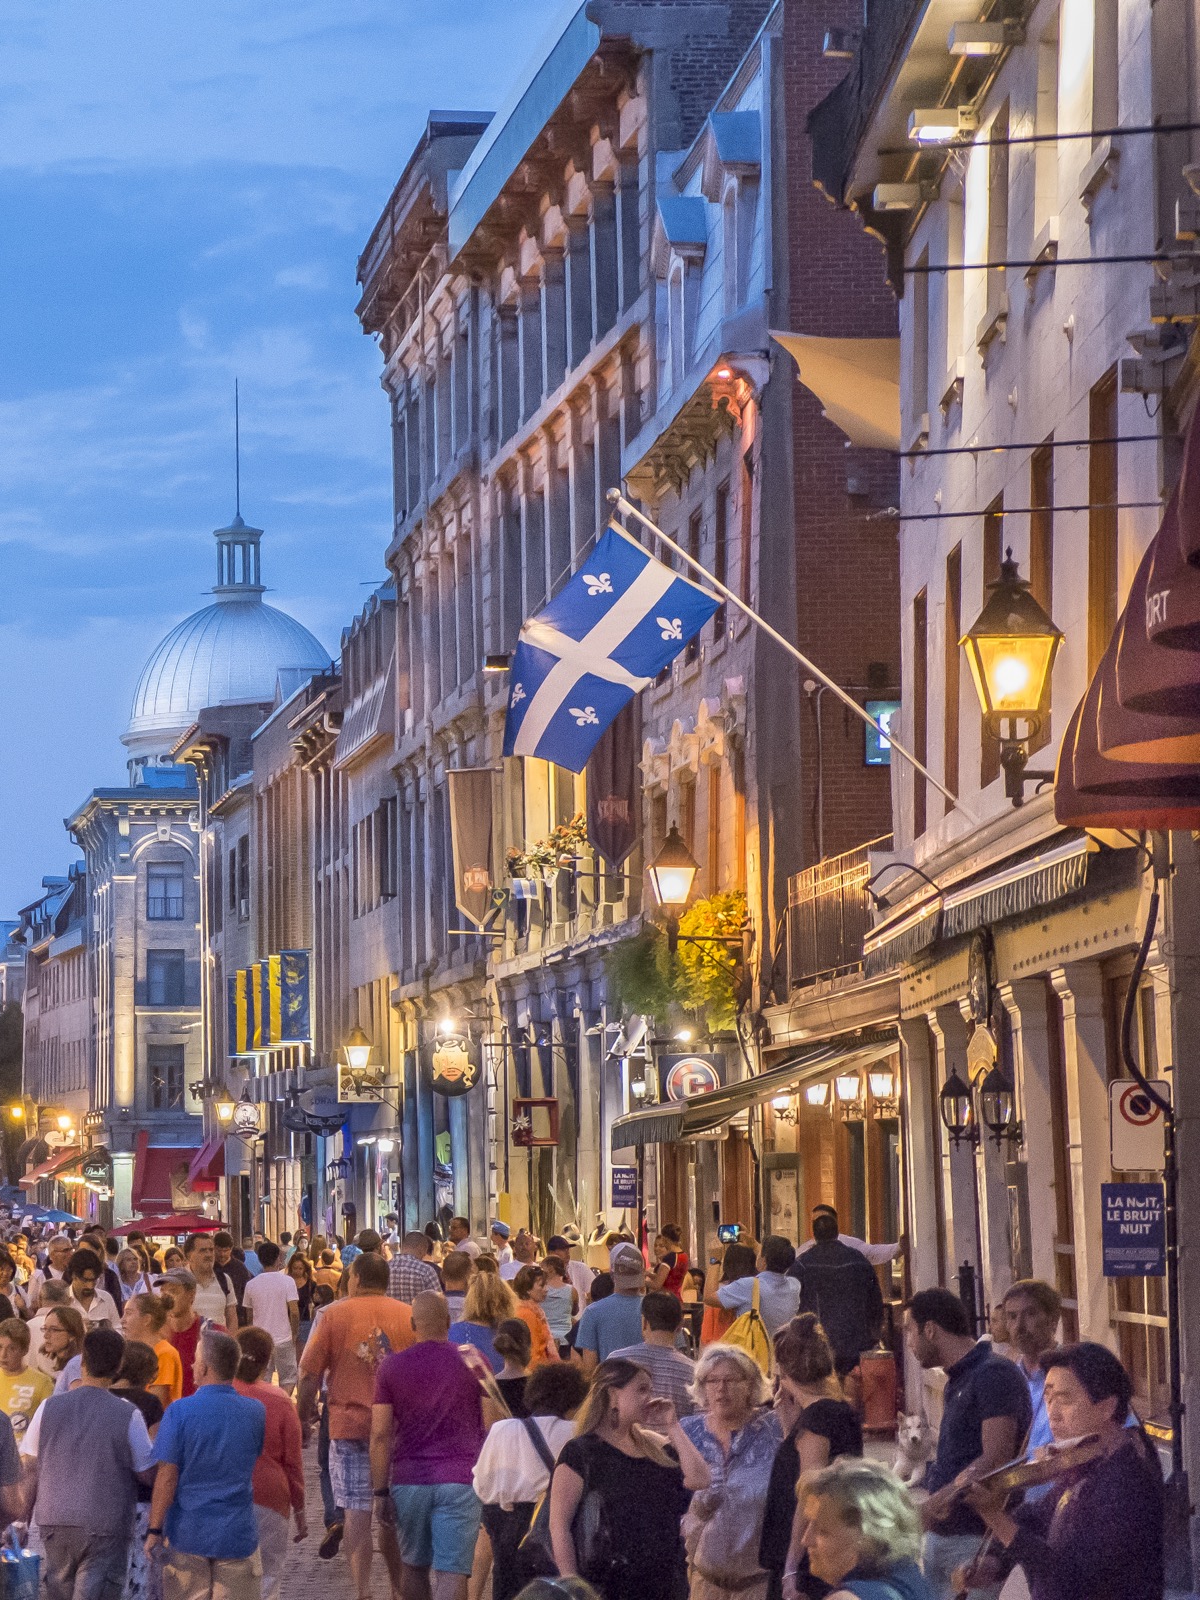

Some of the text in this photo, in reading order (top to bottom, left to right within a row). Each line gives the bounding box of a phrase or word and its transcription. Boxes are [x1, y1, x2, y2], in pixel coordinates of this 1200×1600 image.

[1107, 1197, 1160, 1209] LA NUIT,
[1106, 1210, 1161, 1221] LE BRUIT
[1120, 1223, 1152, 1235] NUIT
